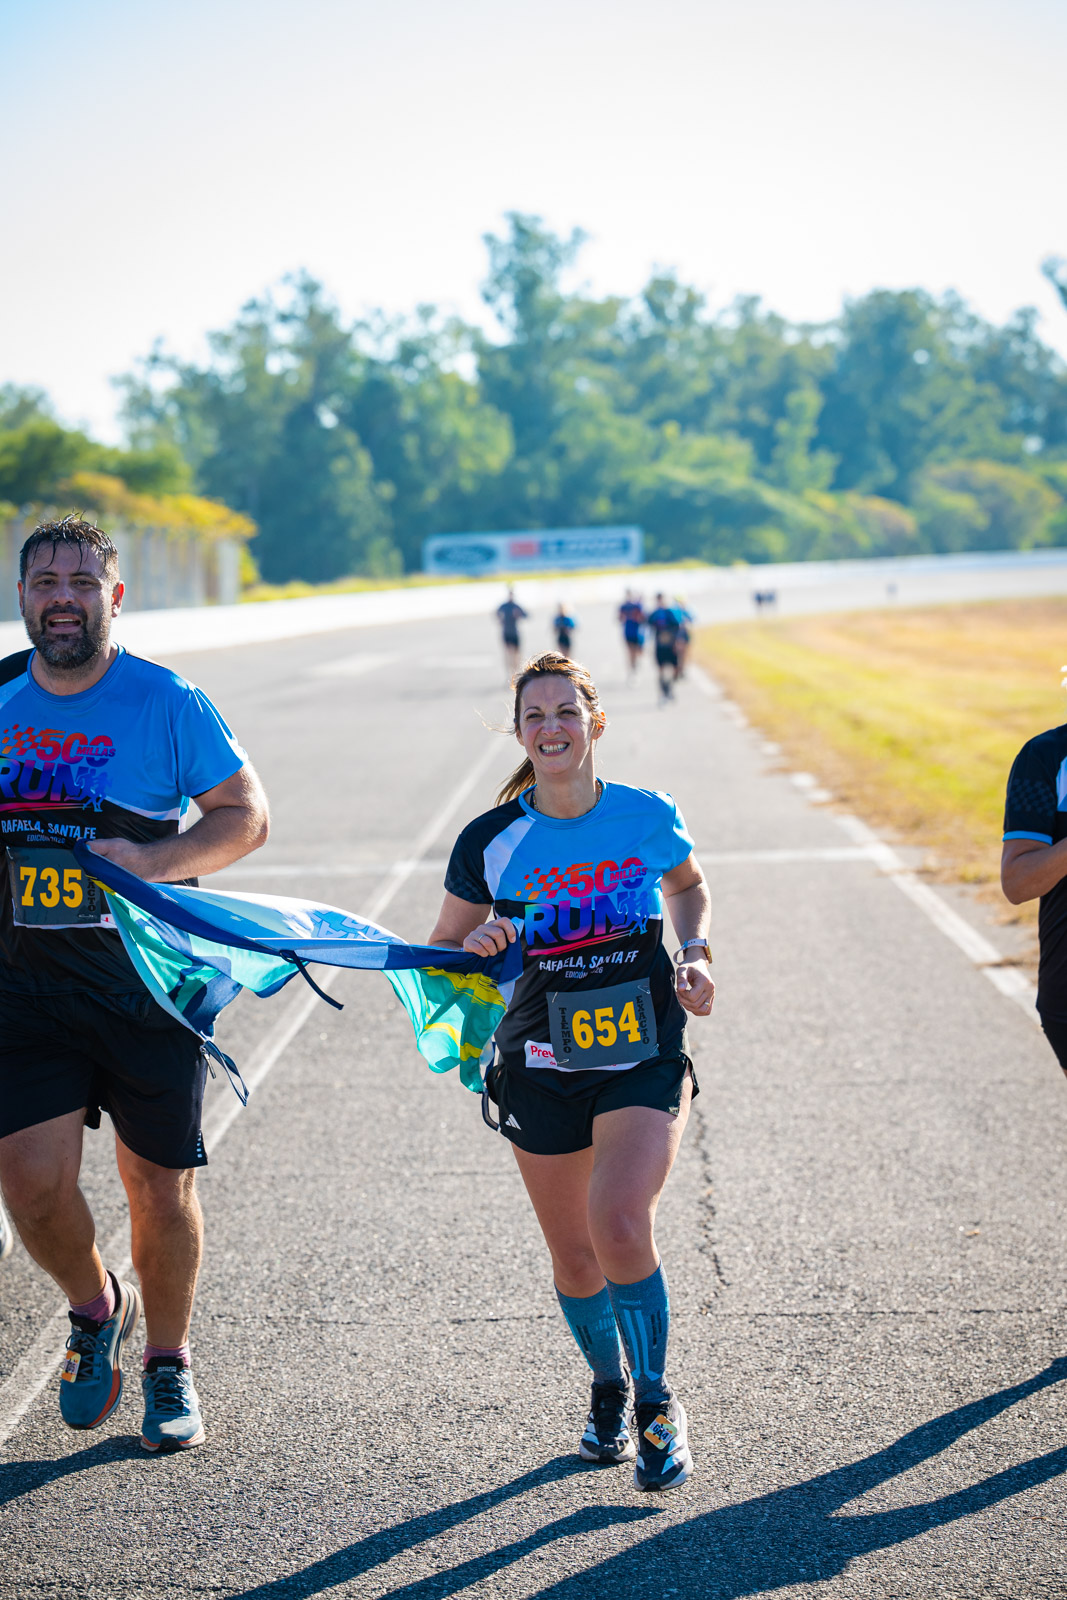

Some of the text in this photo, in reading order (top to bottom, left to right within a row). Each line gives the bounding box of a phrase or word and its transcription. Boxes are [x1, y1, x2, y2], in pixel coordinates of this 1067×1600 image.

[36, 730, 113, 767] 500
[76, 746, 116, 758] MILLAS
[0, 757, 91, 802] RUN
[48, 823, 80, 839] SANTA
[84, 827, 96, 839] FE
[20, 866, 83, 908] 735
[567, 857, 644, 898] 500
[609, 867, 648, 882] MILLAS
[524, 890, 632, 946] RUN
[559, 1007, 572, 1053] TIEMPO
[572, 1001, 641, 1049] 654
[636, 995, 650, 1045] EXACTO
